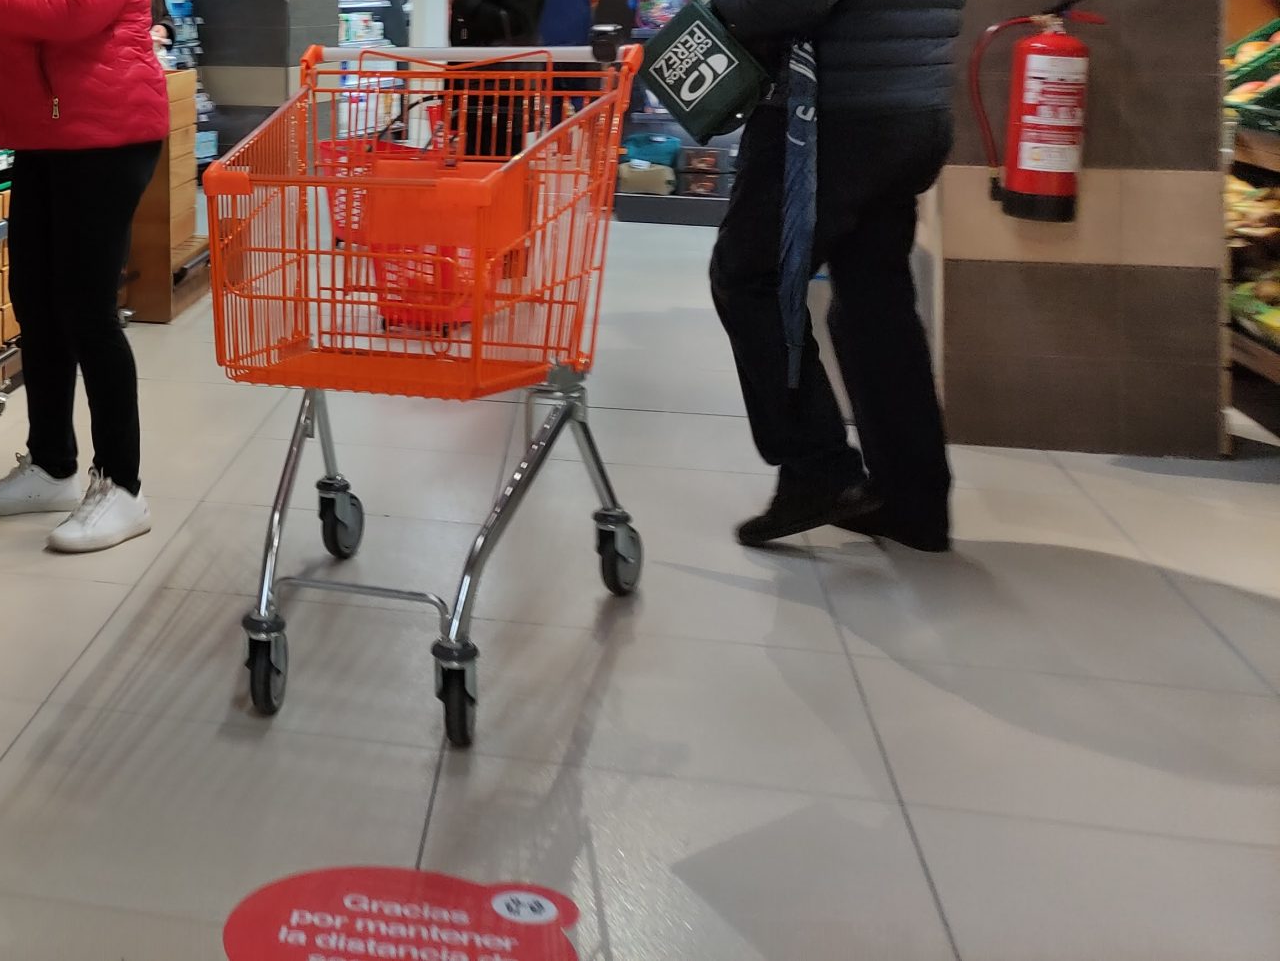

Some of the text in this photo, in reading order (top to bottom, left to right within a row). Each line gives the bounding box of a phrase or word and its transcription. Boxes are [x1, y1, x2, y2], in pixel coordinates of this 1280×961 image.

[655, 27, 707, 78] PEREZ
[666, 39, 713, 85] calzados
[290, 908, 518, 951] por mantener
[342, 893, 470, 925] Gracias
[278, 925, 308, 946] la
